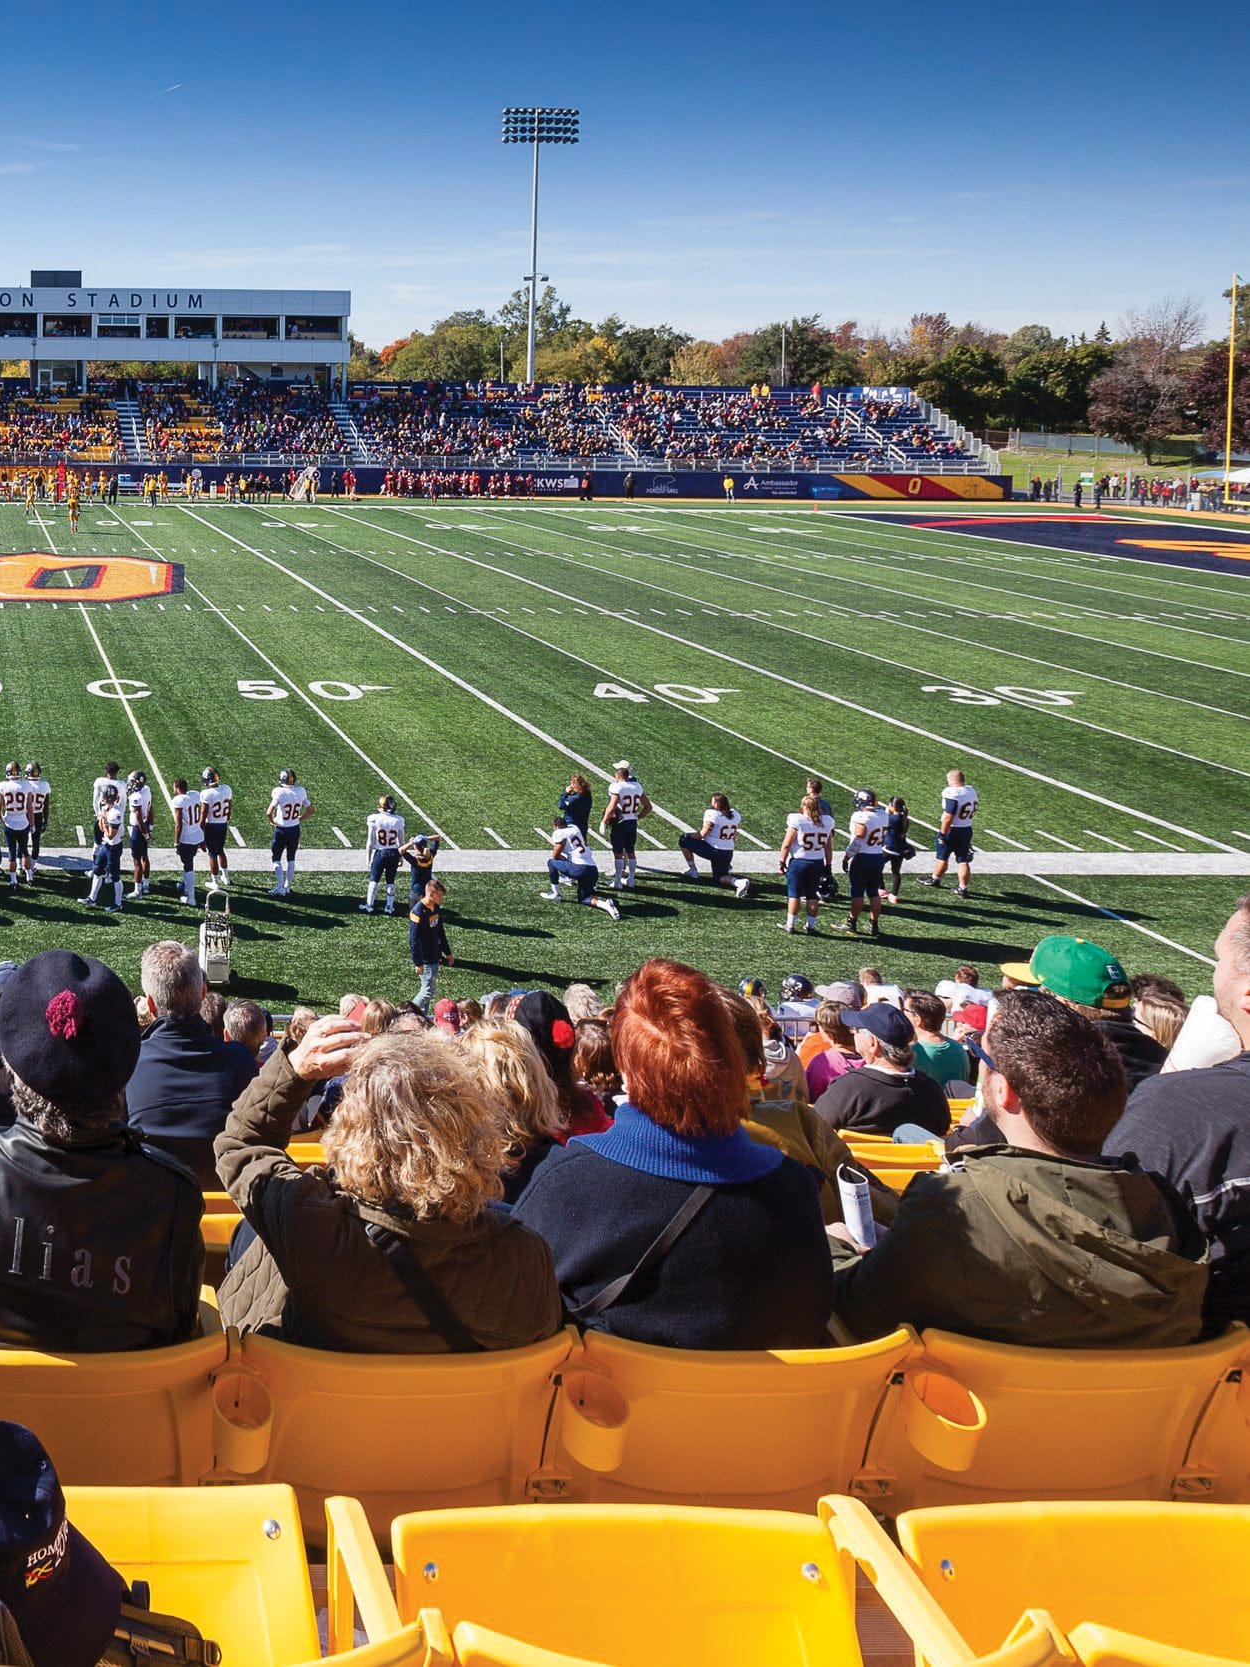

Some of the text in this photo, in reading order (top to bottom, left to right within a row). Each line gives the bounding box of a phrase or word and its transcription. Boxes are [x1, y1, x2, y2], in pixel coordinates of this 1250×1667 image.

[67, 293, 203, 308] STADIUM
[535, 478, 564, 488] KWS
[86, 679, 153, 699] C
[236, 680, 364, 701] 50
[592, 683, 720, 704] 40
[920, 686, 1074, 706] 30
[4, 791, 26, 812] 29
[282, 803, 301, 820] 36
[187, 803, 201, 826] 10
[377, 829, 398, 847] 82
[801, 832, 829, 852] 55
